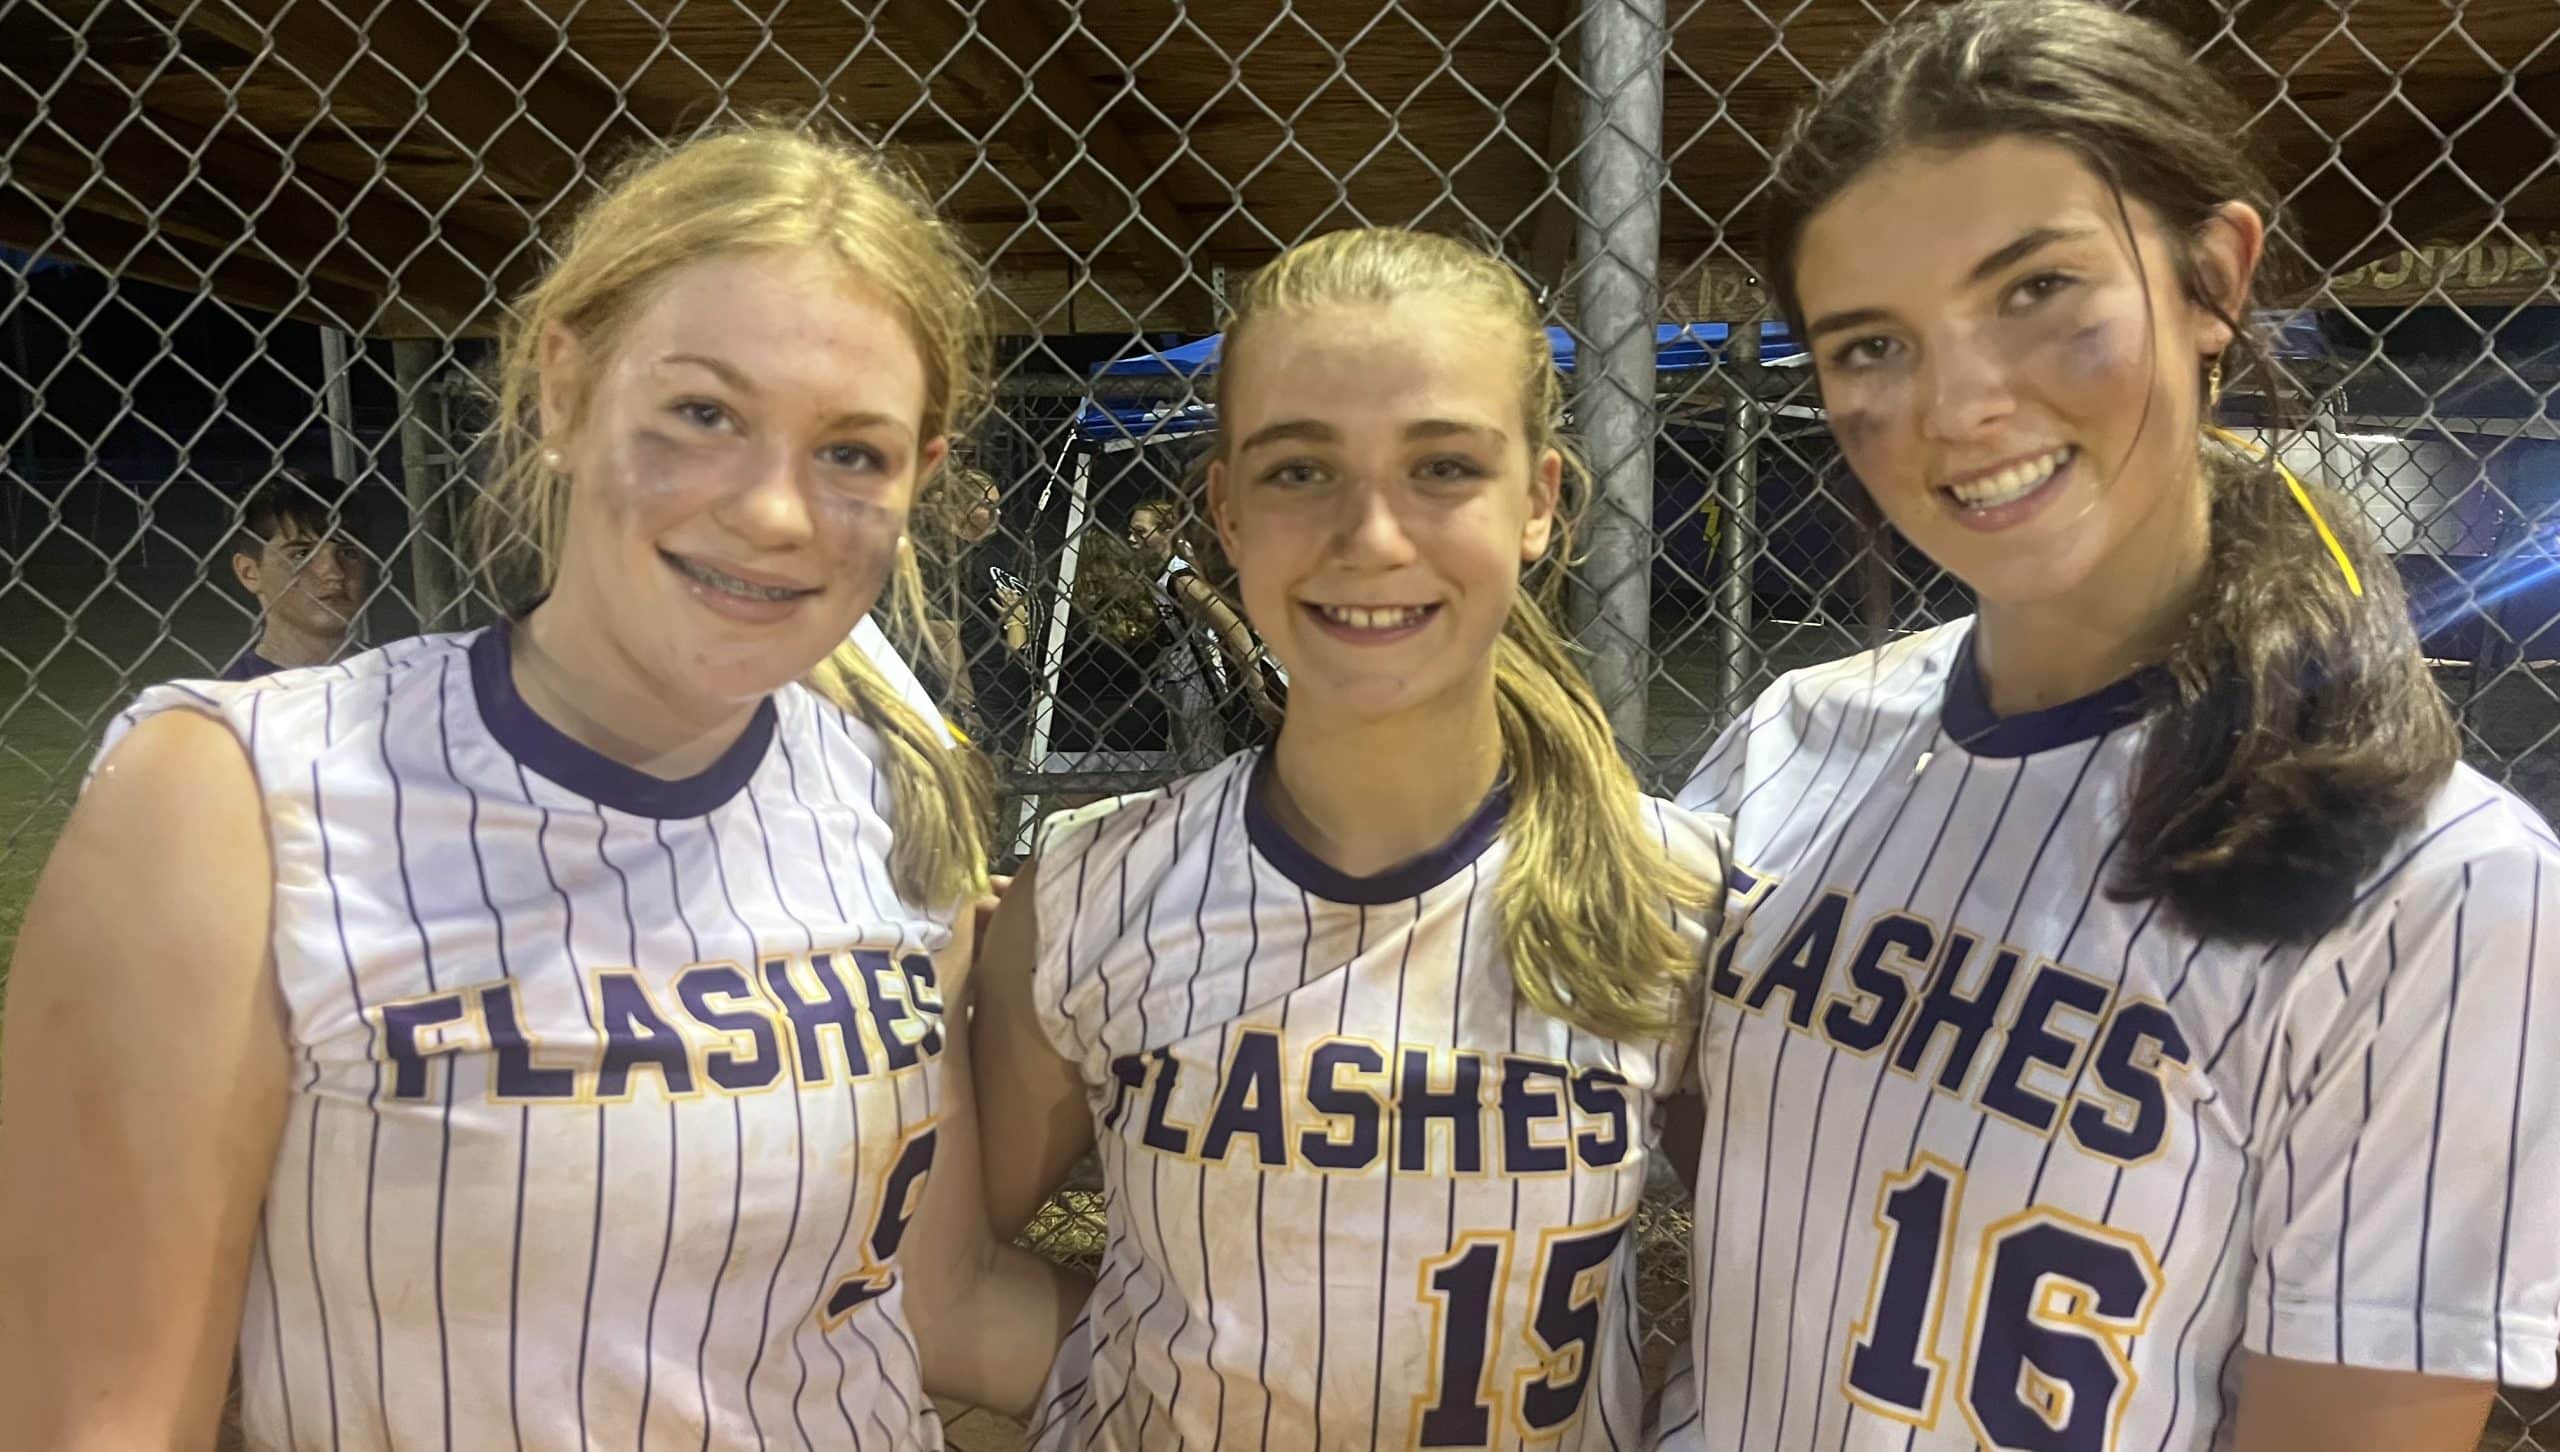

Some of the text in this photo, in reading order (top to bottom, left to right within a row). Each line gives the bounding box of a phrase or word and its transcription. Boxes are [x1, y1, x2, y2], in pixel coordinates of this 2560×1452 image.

[379, 945, 946, 1101] FLASHES
[1708, 862, 2191, 1162] LASHES
[1414, 1213, 1636, 1451] 15
[1842, 1155, 2162, 1452] 16
